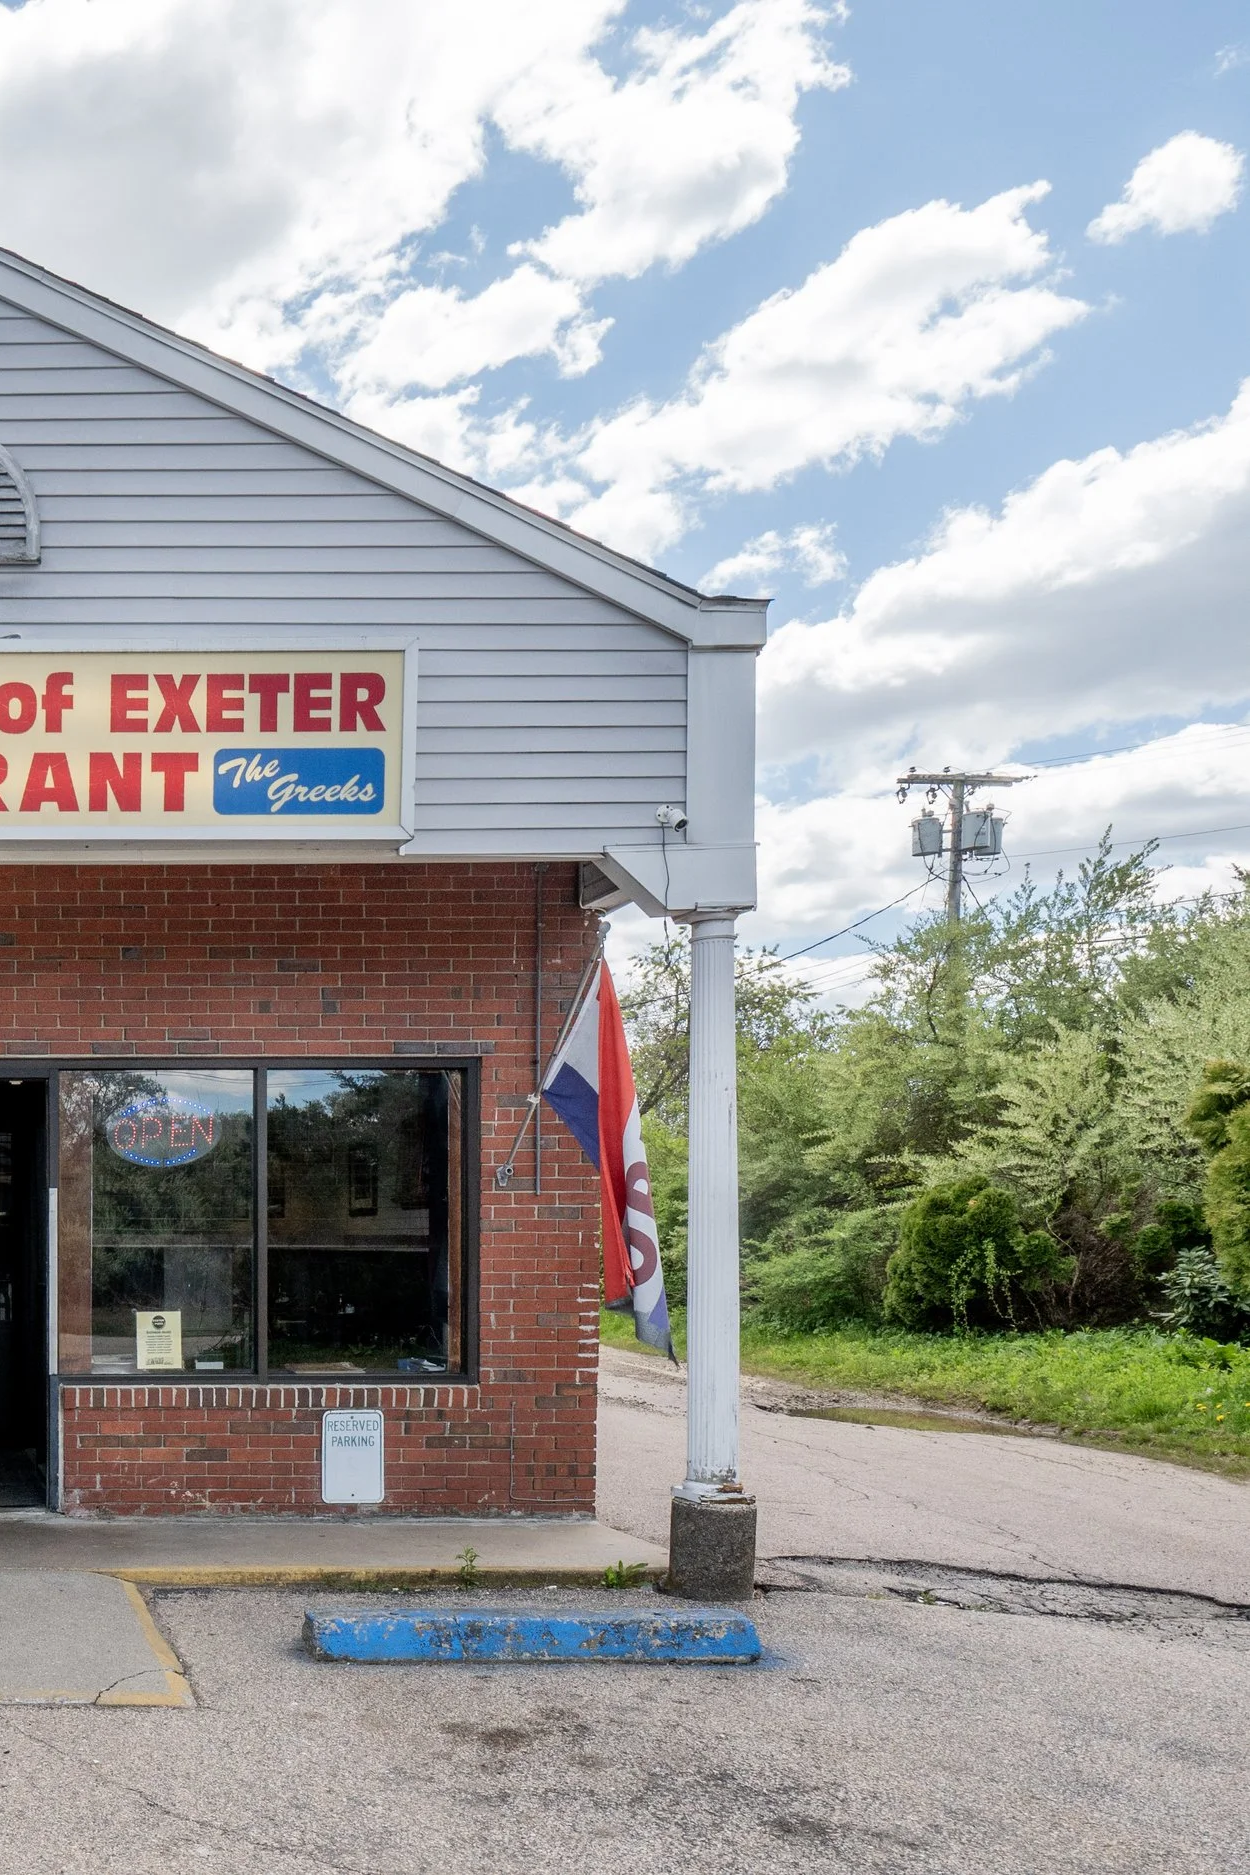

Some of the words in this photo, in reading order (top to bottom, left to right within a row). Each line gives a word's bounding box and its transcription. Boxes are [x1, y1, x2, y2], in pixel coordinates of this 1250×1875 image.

[110, 672, 387, 733] EXETER
[218, 753, 280, 788] The
[267, 773, 377, 813] Greeks
[113, 1113, 216, 1150] OPEN
[327, 1420, 379, 1432] RESERVED
[331, 1435, 375, 1447] PARKING
